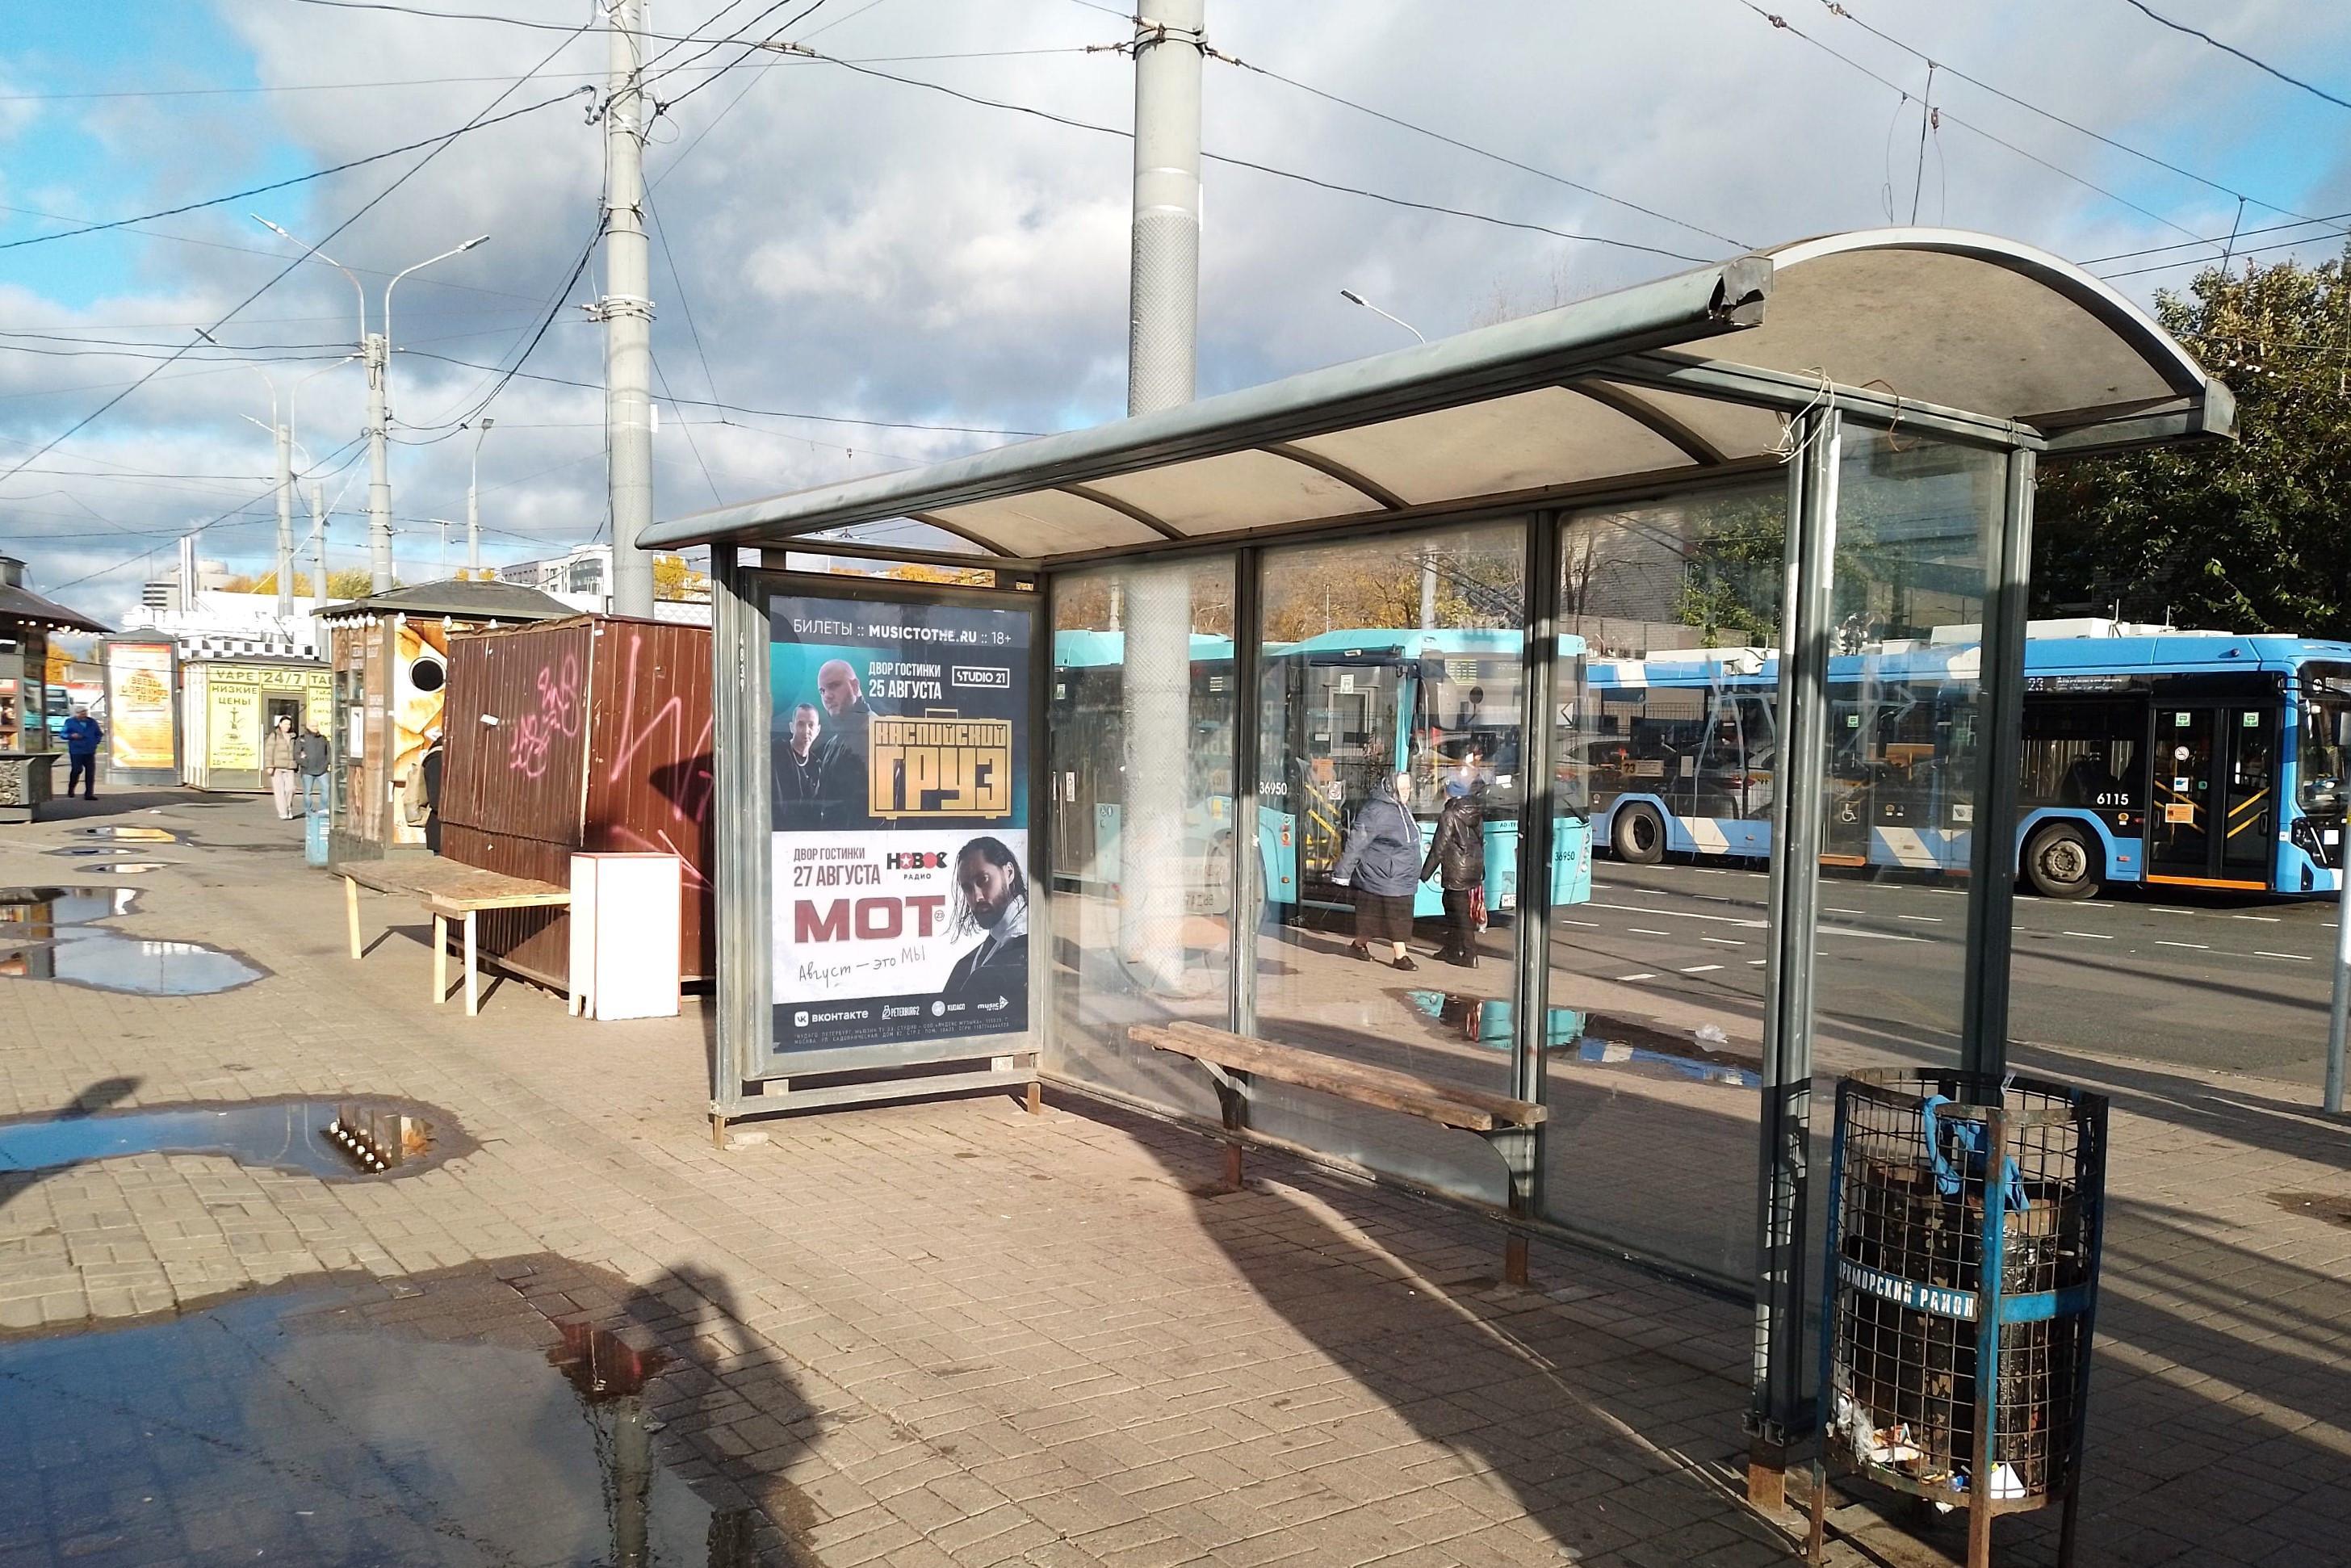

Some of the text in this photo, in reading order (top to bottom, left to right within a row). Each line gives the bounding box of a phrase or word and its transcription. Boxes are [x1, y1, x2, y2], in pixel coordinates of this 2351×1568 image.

[794, 618, 853, 635] БИЛЕТЫ
[869, 625, 977, 643] MUSICTOTHE.RU
[991, 631, 1011, 644] 18+
[216, 670, 254, 681] VAPE
[869, 662, 941, 677] ДВОР ГОСТИНКИ
[264, 673, 303, 685] 24/7
[957, 672, 1005, 684] STUDIO 21
[2028, 678, 2043, 691] 23
[212, 685, 258, 694] НИЗКИЕ
[869, 679, 942, 699] 25 АВГУСТА
[219, 697, 251, 706] ЦЕНЫ
[876, 723, 1006, 746] КАСПИЙСКИЙ
[876, 746, 1006, 810] ГРУЗ
[1259, 781, 1288, 795] 36950
[2097, 793, 2129, 805] 6115
[794, 847, 865, 862] ДВОР ГОСТИНКИ
[1554, 851, 1575, 862] 36950
[794, 864, 881, 887] 27 АВГУСТА
[794, 895, 945, 943] МОТ
[799, 962, 851, 988] Август
[873, 958, 896, 970] это
[901, 945, 925, 964] МЫ
